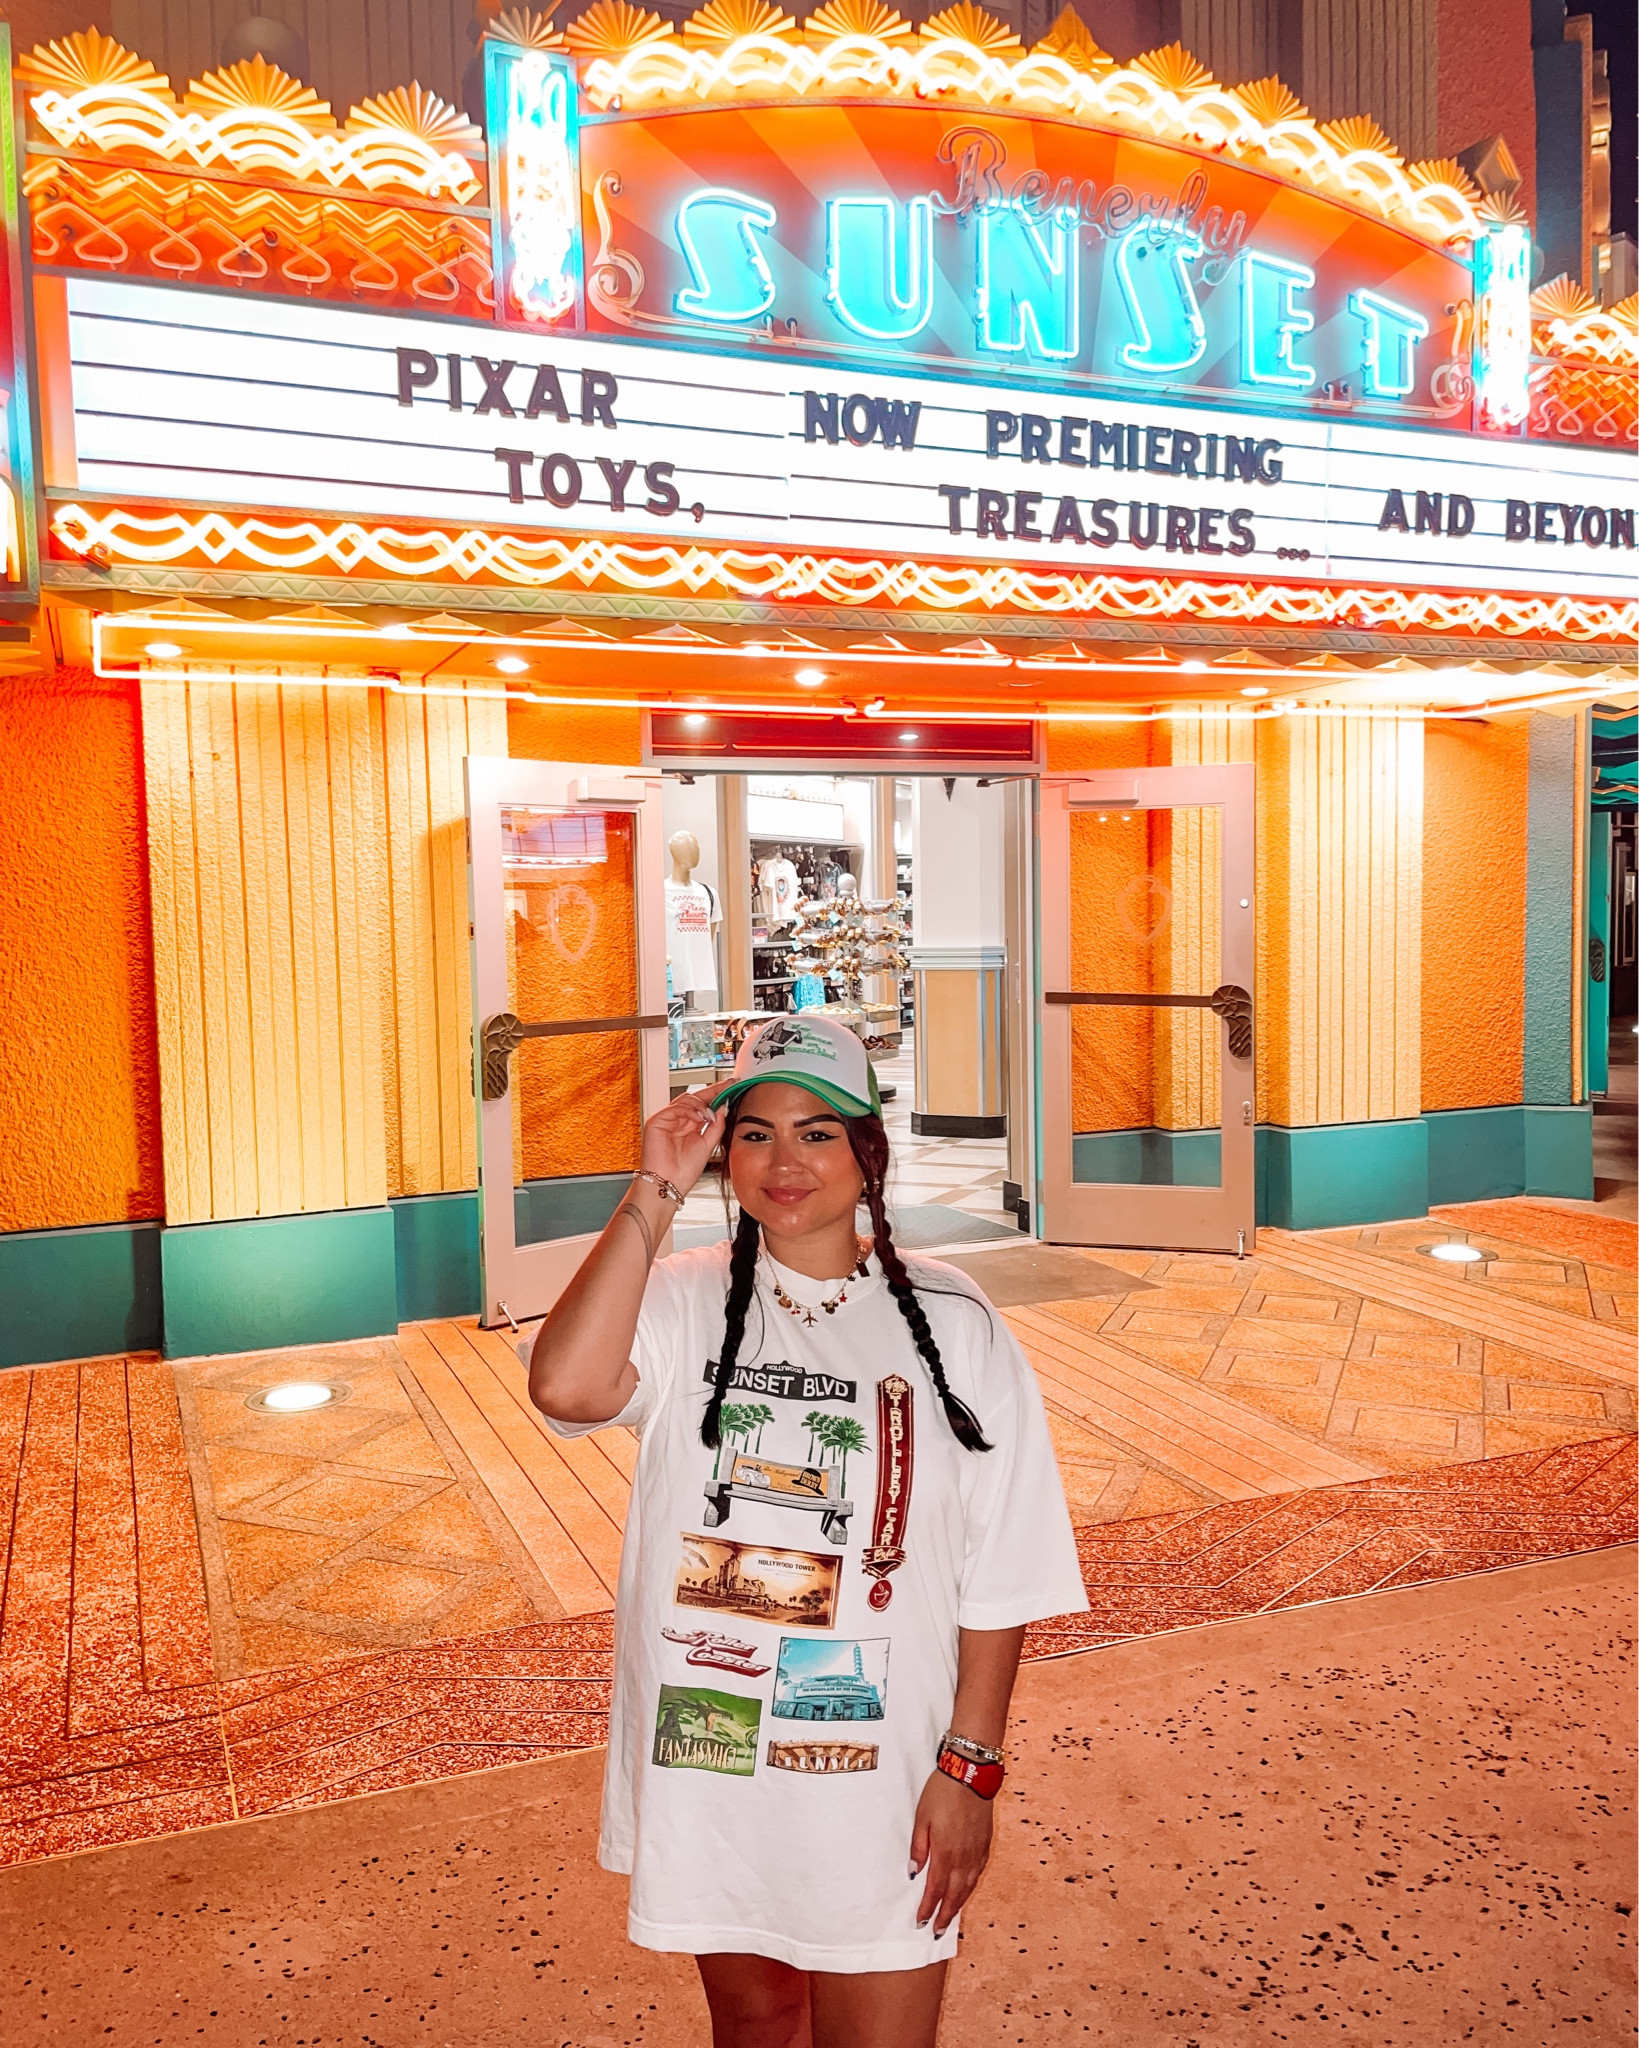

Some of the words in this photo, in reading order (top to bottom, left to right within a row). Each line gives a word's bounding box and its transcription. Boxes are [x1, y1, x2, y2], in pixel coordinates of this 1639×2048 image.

[930, 126, 1247, 286] Beverly
[672, 186, 1430, 400] SUNSET
[396, 346, 618, 429] PIXAR
[804, 390, 922, 451] NOW
[985, 409, 1284, 484] PREMIERING
[494, 447, 705, 523] TOYS,
[1378, 488, 1475, 539] AND
[1505, 498, 1635, 550] BEYON
[766, 1364, 803, 1374] HOLLYWOOD
[802, 1376, 849, 1397] BLVD
[800, 1477, 820, 1490] DERBY
[888, 1393, 904, 1504] TROLLEY
[881, 1507, 898, 1546] CAR
[758, 1558, 794, 1570] HOLLYWOOD
[794, 1562, 817, 1573] TOWER
